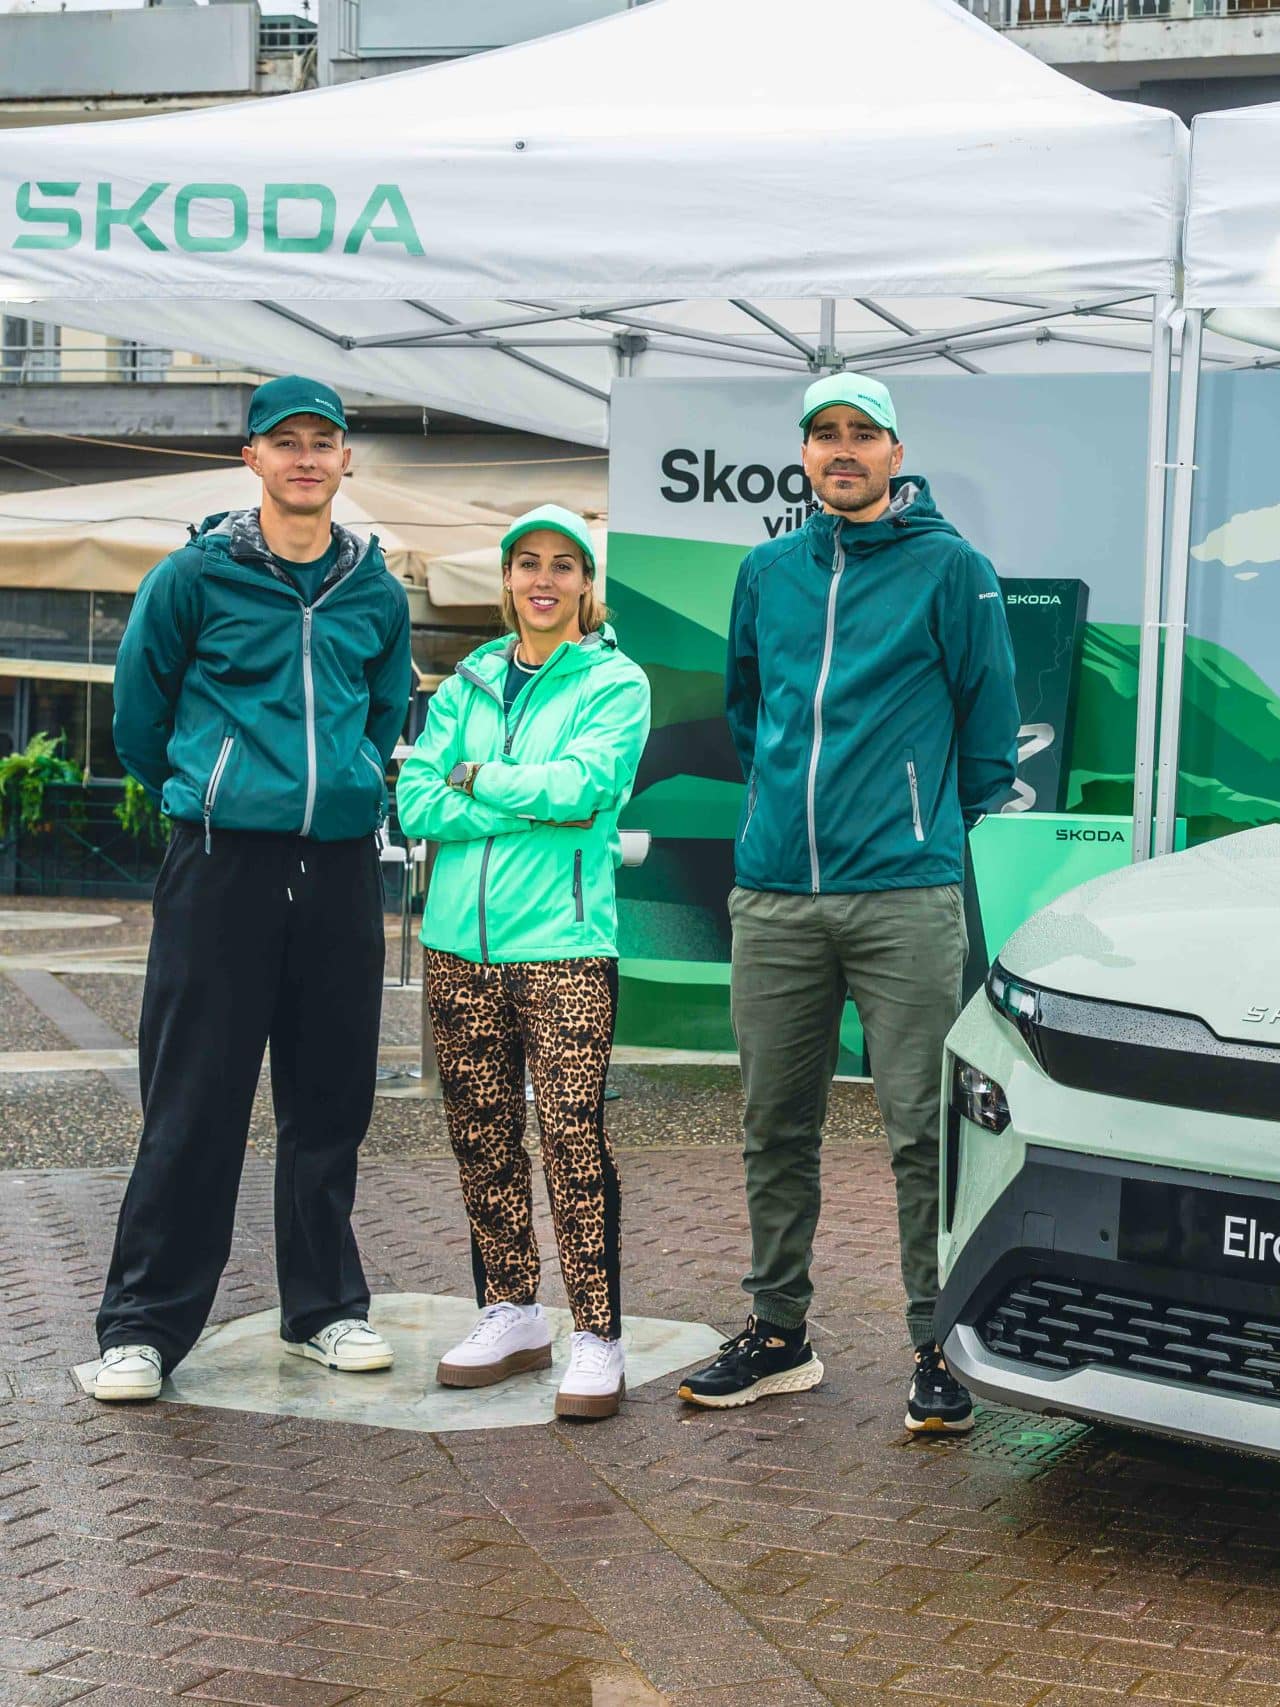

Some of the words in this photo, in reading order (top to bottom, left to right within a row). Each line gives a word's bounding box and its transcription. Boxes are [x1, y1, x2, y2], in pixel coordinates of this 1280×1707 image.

[12, 181, 427, 257] SKODA
[660, 448, 813, 504] Skod
[1007, 595, 1061, 604] SKODA
[1056, 829, 1125, 842] SKODA
